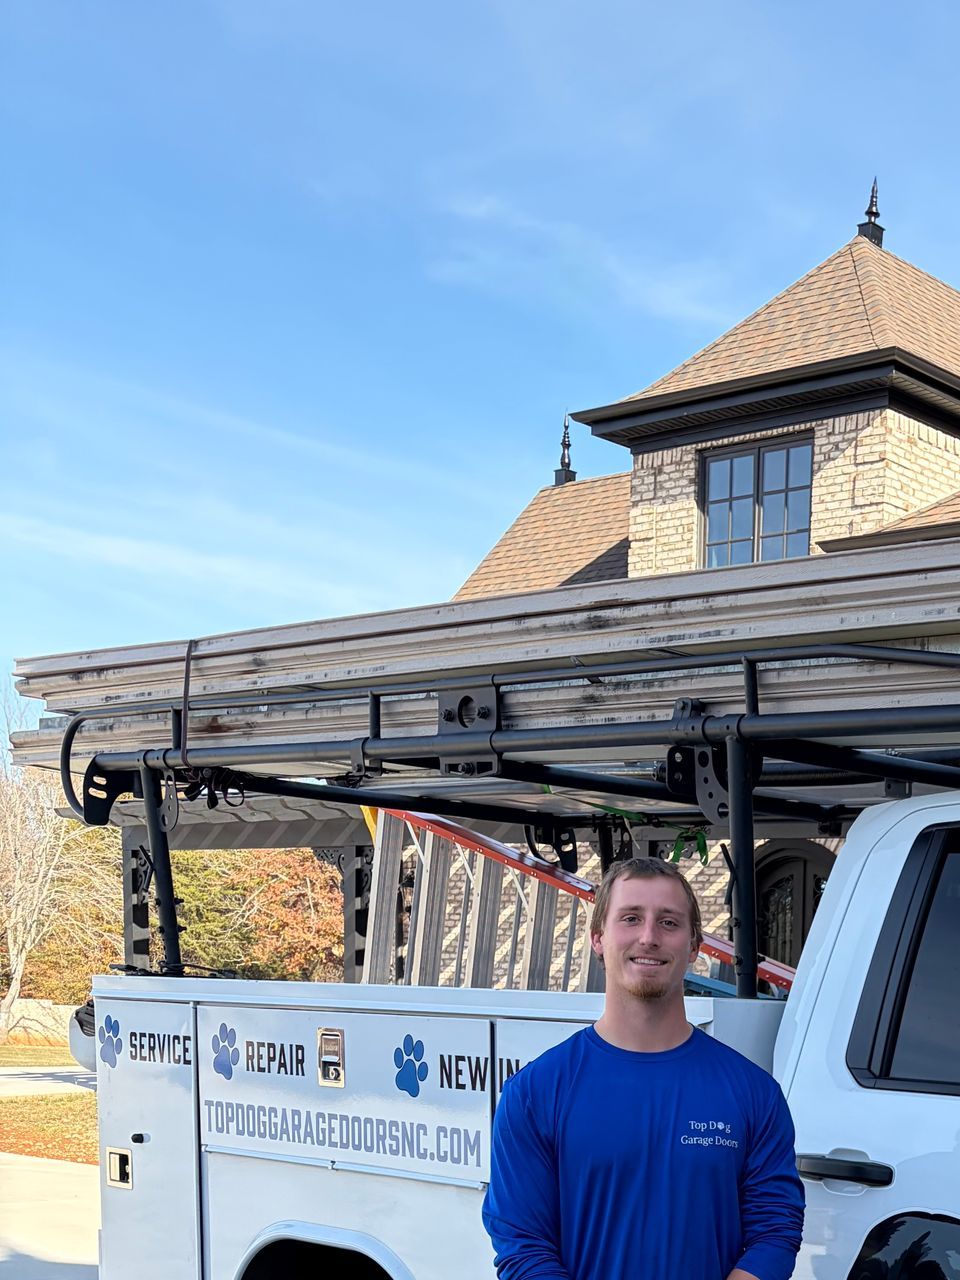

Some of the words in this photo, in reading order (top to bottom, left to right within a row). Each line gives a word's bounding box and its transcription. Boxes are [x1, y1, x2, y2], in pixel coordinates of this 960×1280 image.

[129, 1032, 192, 1066] SERVICE
[246, 1041, 305, 1076] REPAIR
[439, 1054, 489, 1092] NEW
[204, 1100, 482, 1167] TOPDOGGARAGEDOORSNC.COM
[681, 1135, 713, 1147] Garage
[715, 1136, 738, 1148] Doors
[689, 1121, 707, 1132] Top
